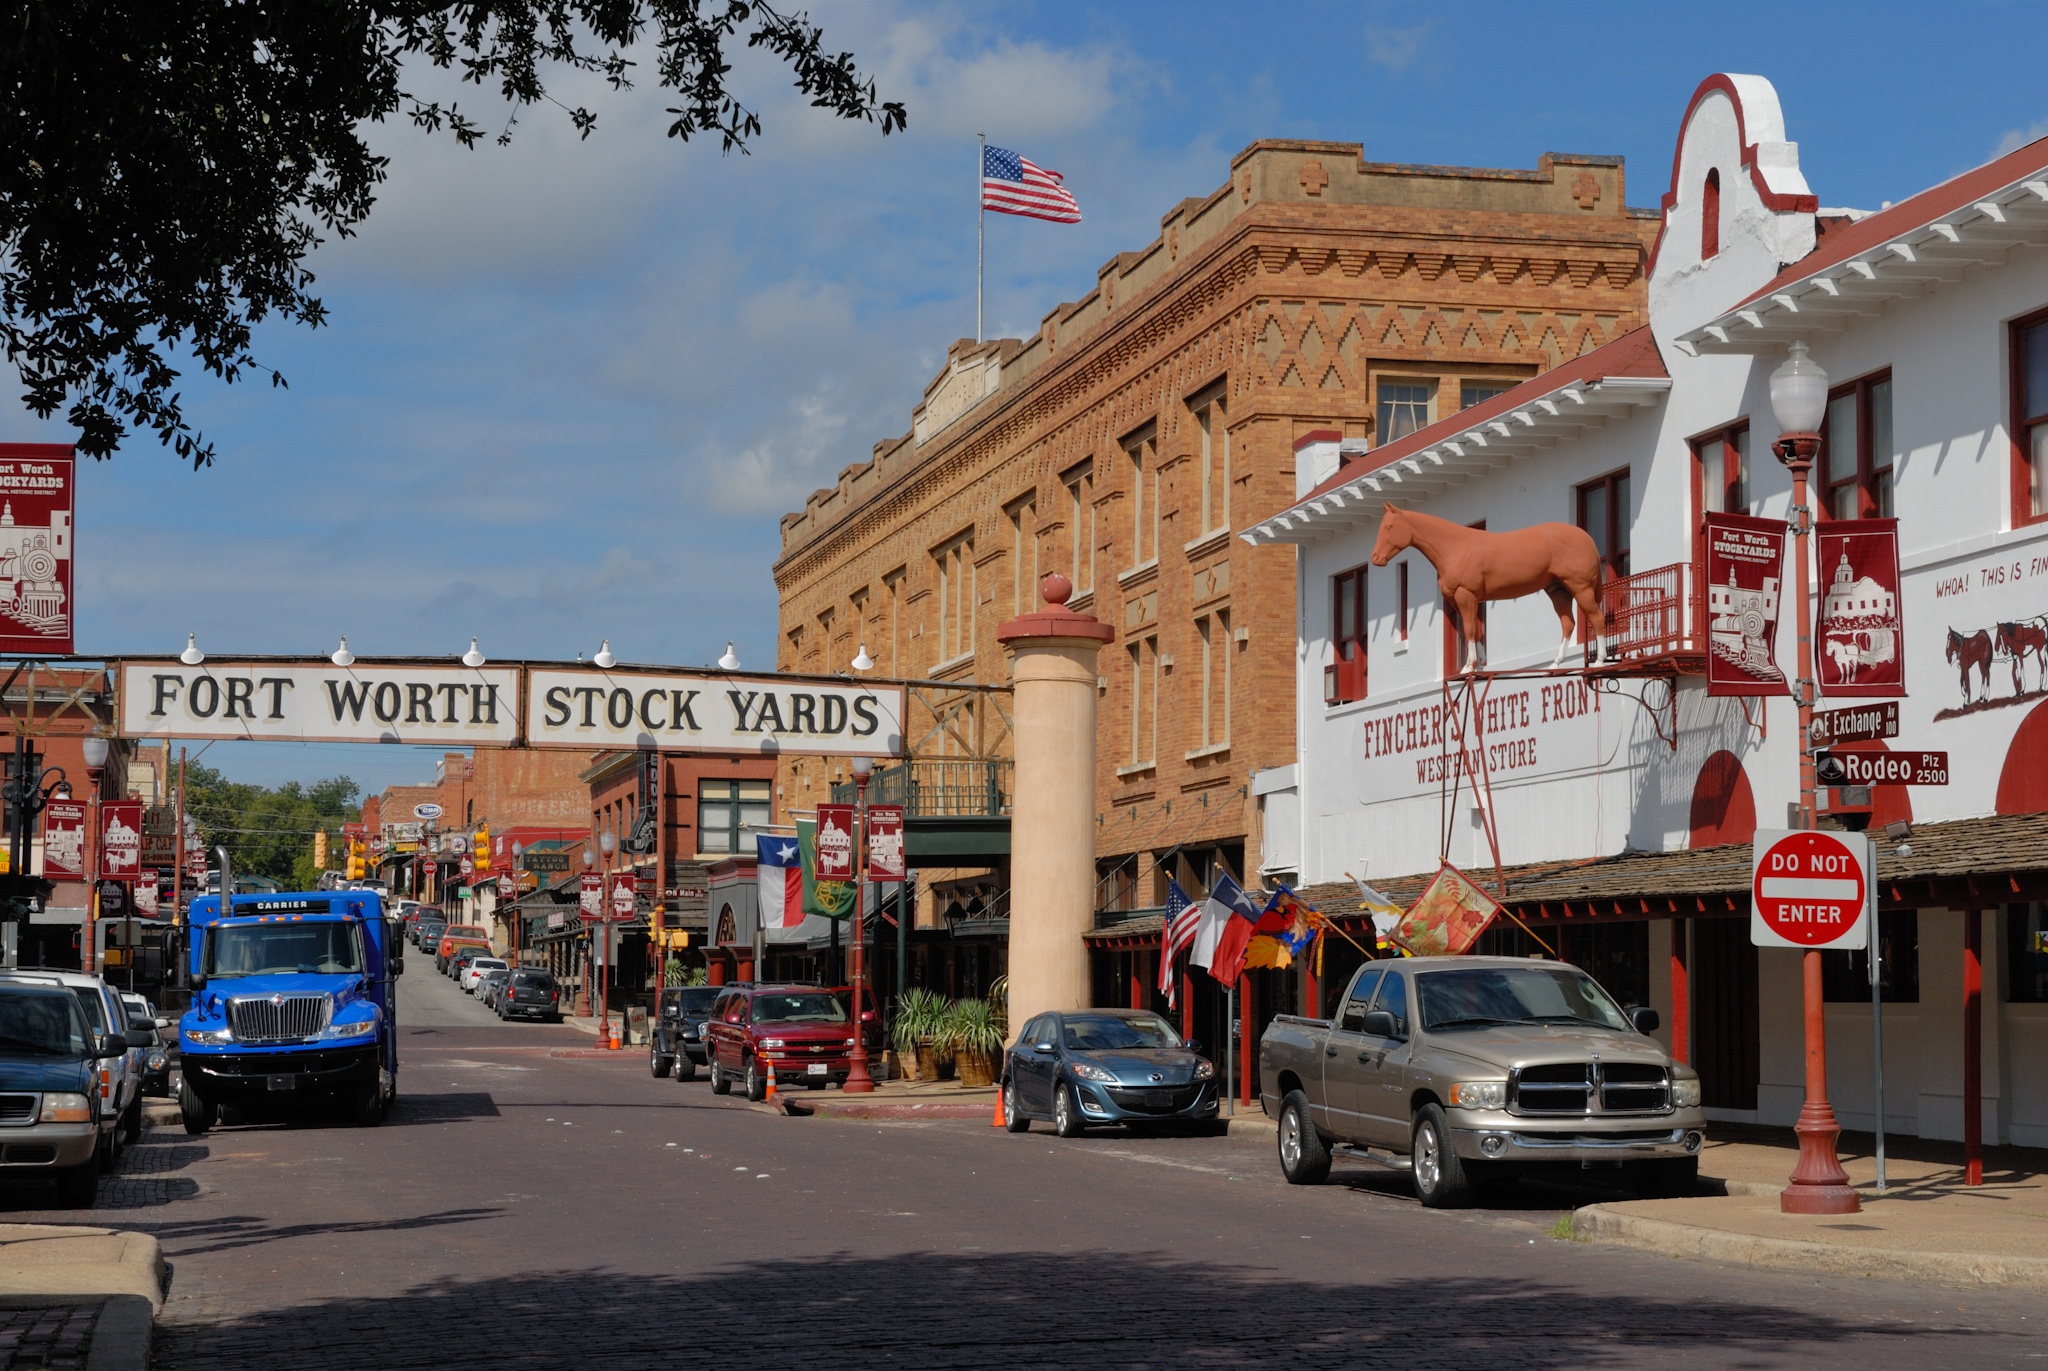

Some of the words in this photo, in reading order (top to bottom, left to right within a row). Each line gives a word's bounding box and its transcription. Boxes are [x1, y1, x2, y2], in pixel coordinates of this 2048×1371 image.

[0, 464, 14, 474] ort
[20, 463, 54, 475] Worth
[0, 476, 64, 488] CKYARDS
[1722, 531, 1739, 542] Fort
[1744, 533, 1769, 546] Worth
[1713, 541, 1776, 559] STOCKYARDS
[1936, 573, 1969, 599] WHOA!
[1981, 566, 2005, 588] THIS
[2010, 561, 2022, 582] IS
[2030, 556, 2048, 577] FIN
[150, 674, 295, 719] FORT
[323, 679, 499, 724] WORTH
[544, 686, 702, 731] STOCK
[726, 690, 879, 737] YARDS
[1541, 678, 1603, 724] FRONT
[1887, 705, 1896, 719] Av
[1824, 712, 1830, 737] E
[1833, 709, 1882, 739] Exchange
[1885, 721, 1897, 735] 100
[1489, 737, 1537, 773] STORE
[1922, 754, 1939, 767] Plz
[1846, 754, 1912, 780] Rodeo
[650, 753, 658, 813] EDDY
[1916, 770, 1946, 783] 2500
[533, 862, 568, 870] RANCH
[1771, 853, 1799, 871] DO
[1810, 855, 1849, 873] NOT
[672, 889, 678, 897] N
[680, 889, 695, 897] Main
[257, 900, 308, 910] CARRIER
[1778, 904, 1841, 924] ENTER
